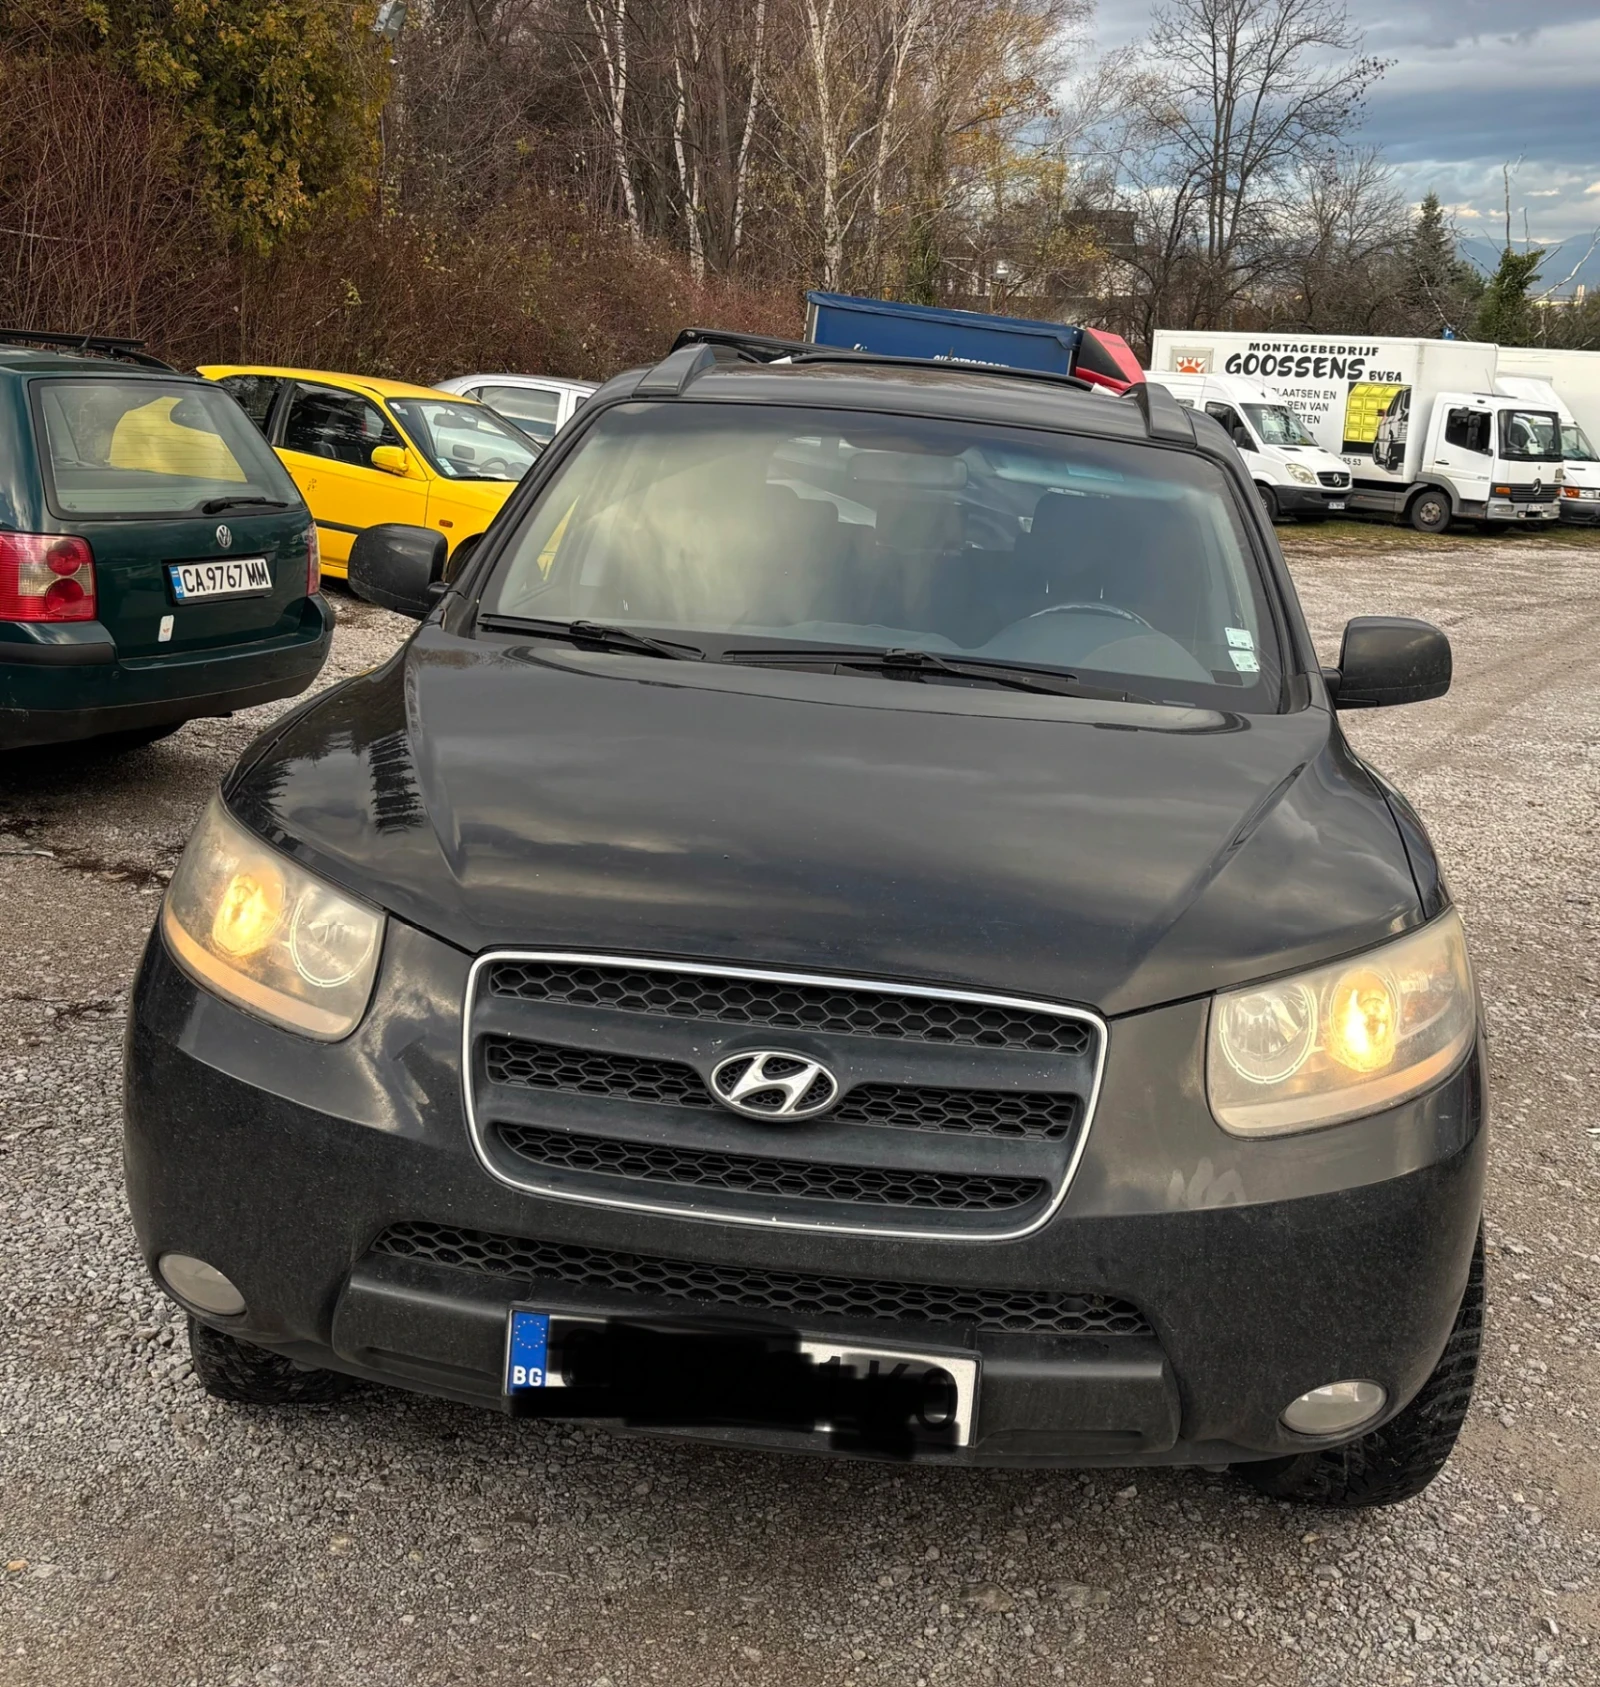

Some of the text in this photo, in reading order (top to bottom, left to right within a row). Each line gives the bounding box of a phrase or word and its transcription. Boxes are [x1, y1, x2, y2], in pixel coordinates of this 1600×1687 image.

[1248, 342, 1379, 357] MONTAGEBEDRIJF
[1225, 353, 1402, 382] GOOSSENS BVBA
[1323, 390, 1337, 400] EN
[1309, 402, 1329, 412] VAN
[513, 1365, 542, 1386] BG
